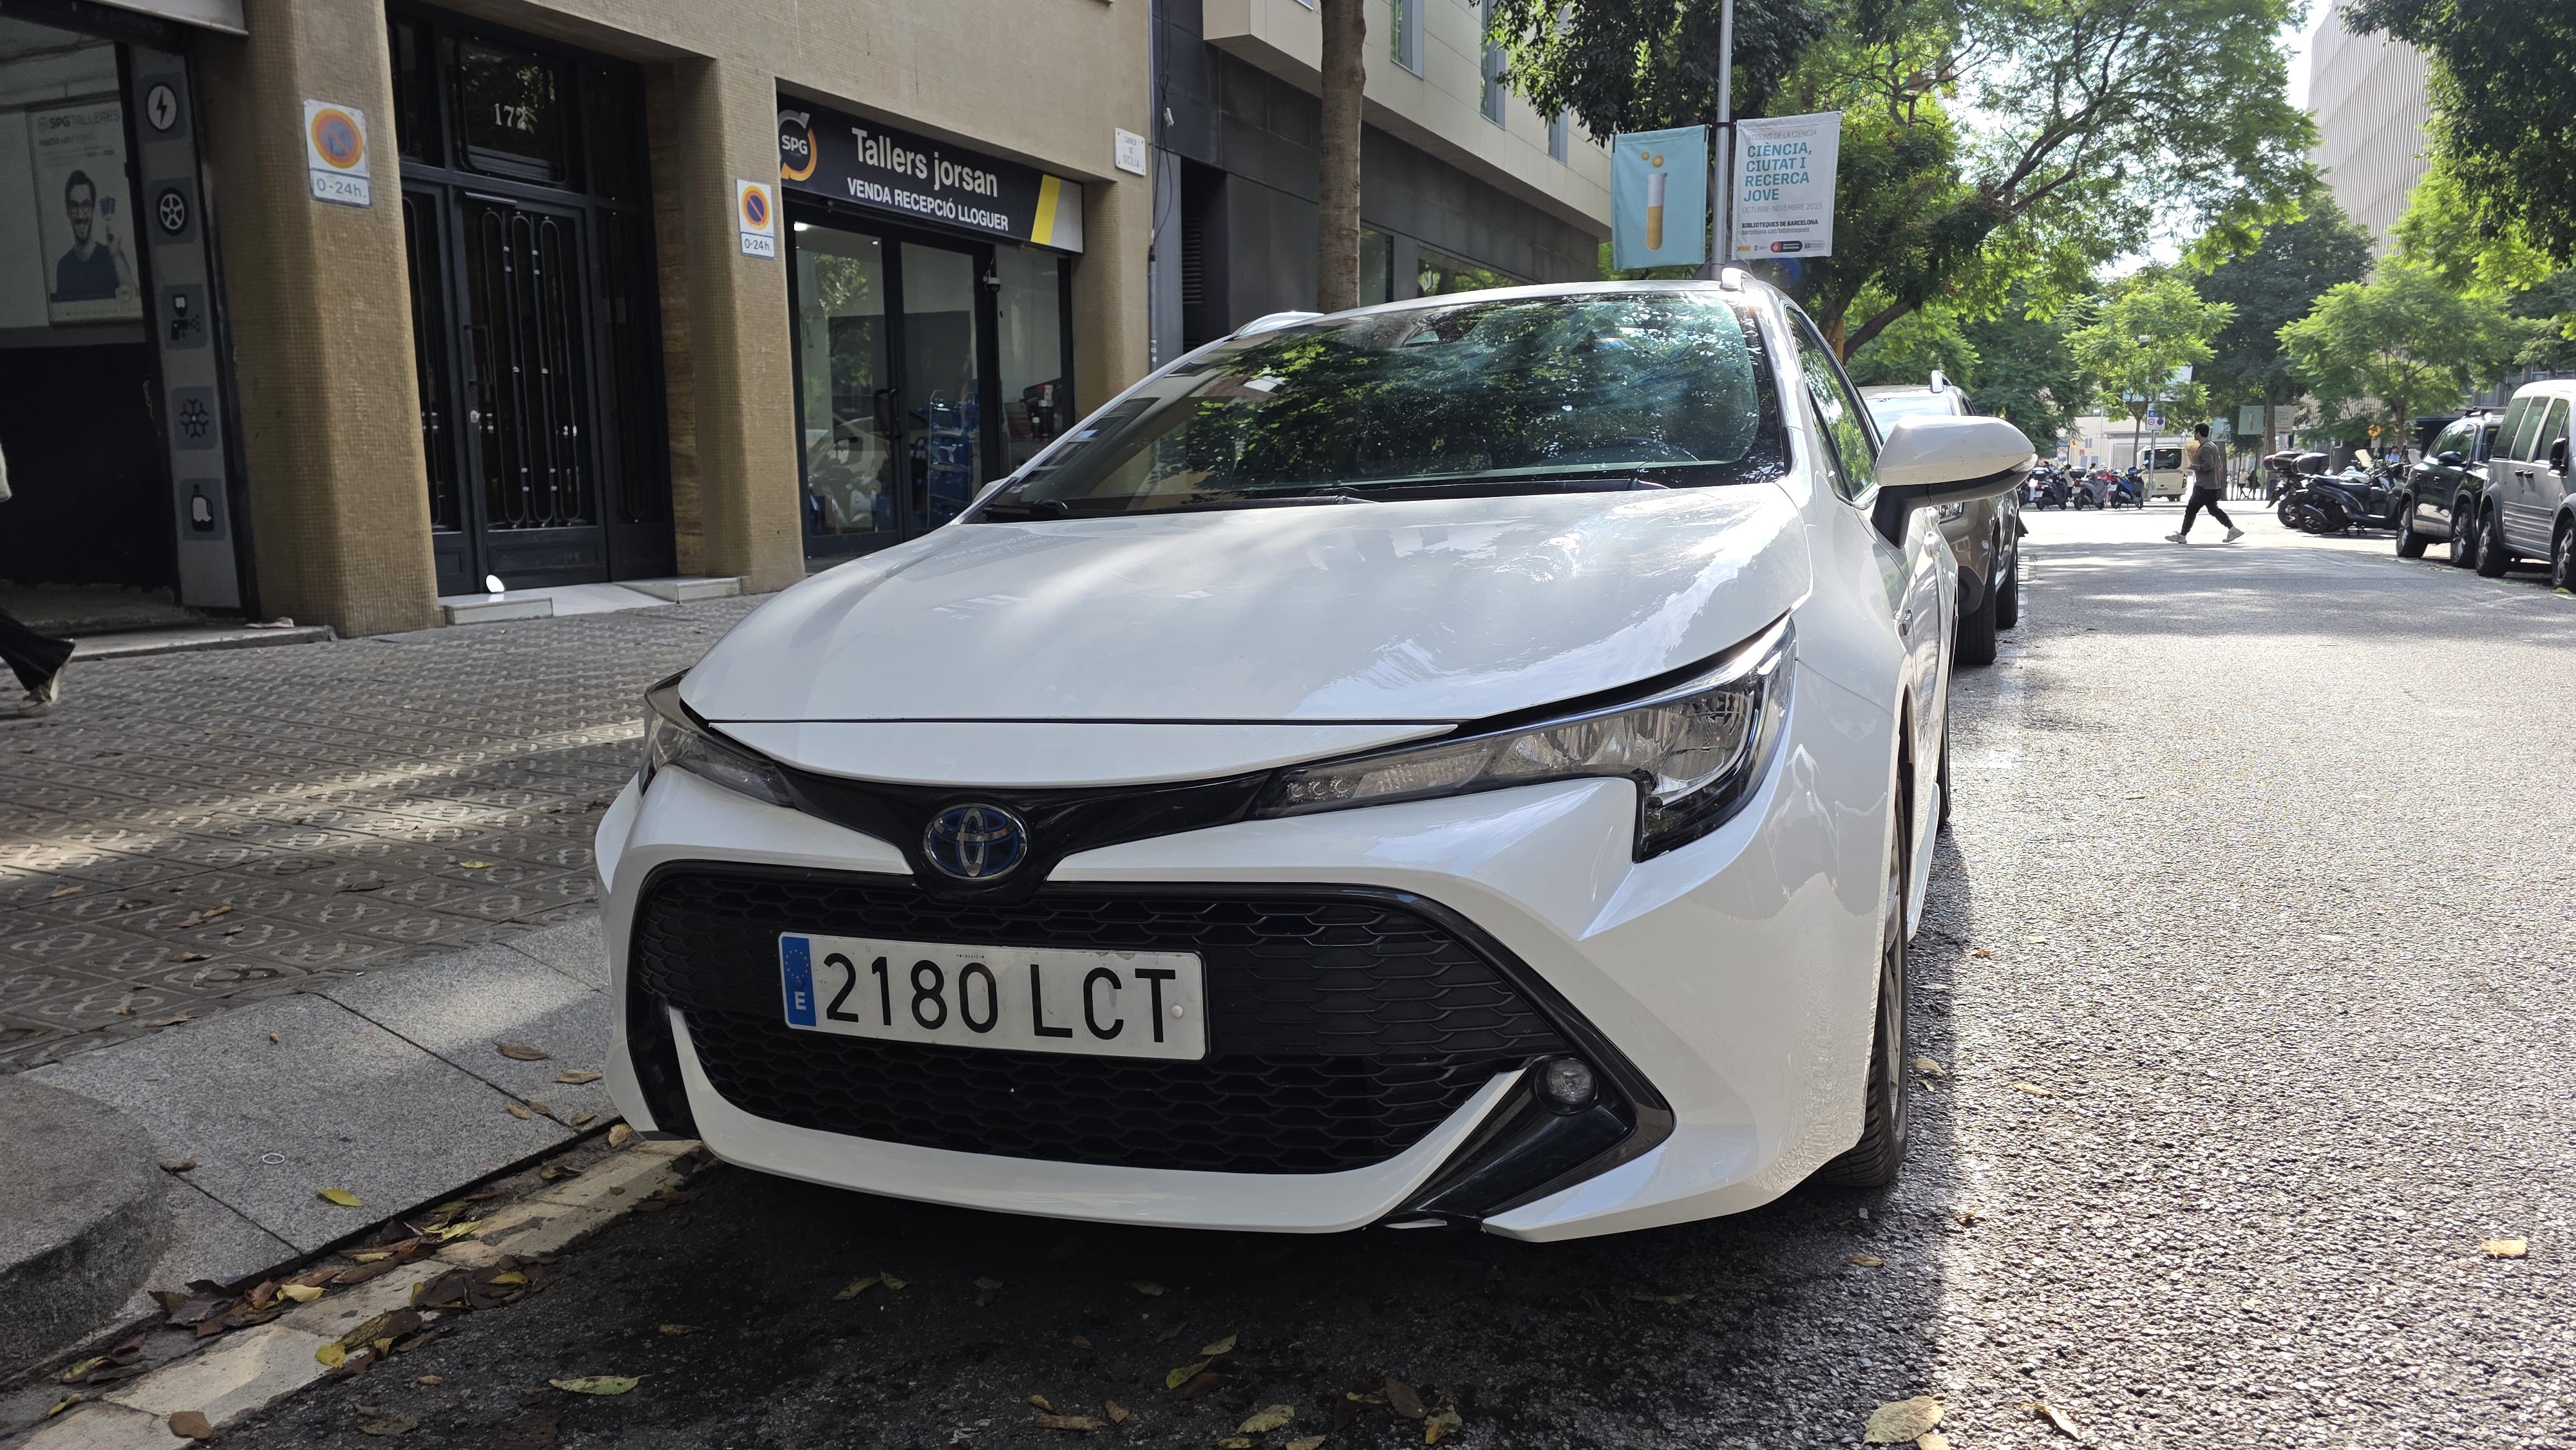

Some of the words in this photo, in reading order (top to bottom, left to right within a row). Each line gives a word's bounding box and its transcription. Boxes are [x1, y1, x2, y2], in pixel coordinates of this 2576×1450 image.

[494, 103, 527, 131] 172
[1792, 129, 1817, 138] CIÈNCIA
[781, 135, 808, 155] SPG
[1747, 142, 1812, 158] CIÈNCIA,
[851, 127, 927, 179] Tallers
[934, 151, 998, 198] jorsan
[1746, 157, 1797, 173] CIUTAT
[1799, 156, 1806, 169] I
[1745, 171, 1810, 187] RECERCA
[847, 177, 892, 205] VENDA
[894, 189, 956, 219] RECEPCIÓ
[958, 204, 1009, 232] LLOGUER
[1743, 189, 1779, 202] JOVE
[1742, 203, 1804, 214] OCTUBRE-NOVEMBRE
[1806, 202, 1823, 211] 2025
[794, 991, 807, 1011] E
[823, 952, 998, 1033] 2180
[1030, 963, 1176, 1043] LCT
